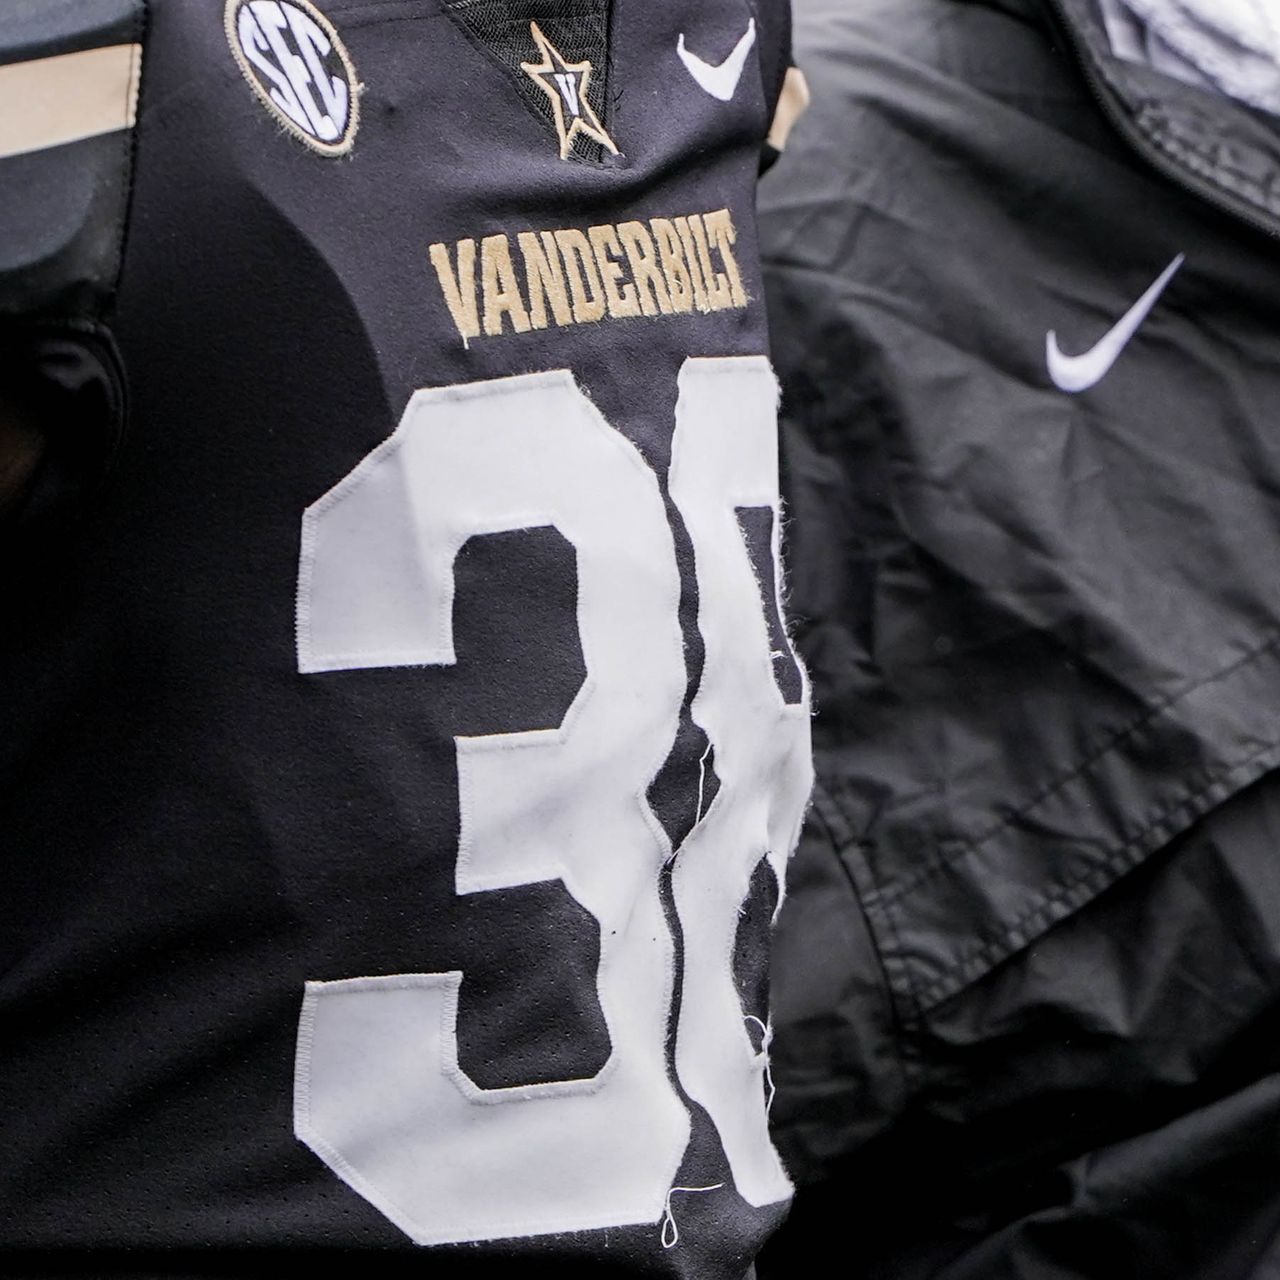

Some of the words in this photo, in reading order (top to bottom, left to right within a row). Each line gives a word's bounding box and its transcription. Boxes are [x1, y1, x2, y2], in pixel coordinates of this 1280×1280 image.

[238, 0, 348, 141] SEC
[553, 73, 580, 116] V
[429, 208, 752, 340] VANDERBILT
